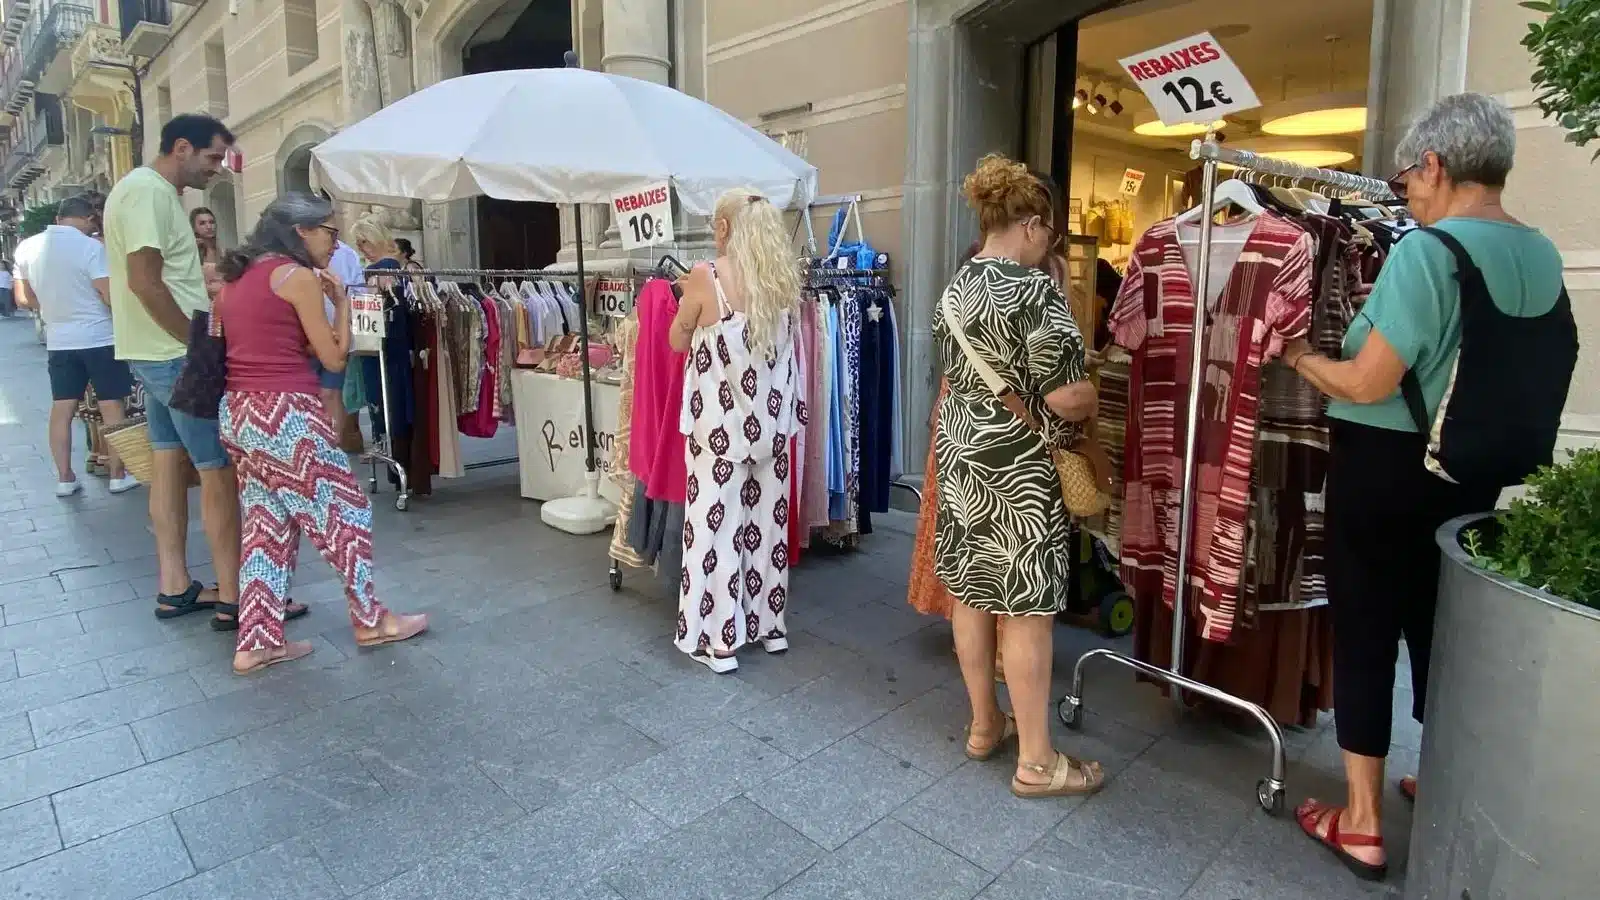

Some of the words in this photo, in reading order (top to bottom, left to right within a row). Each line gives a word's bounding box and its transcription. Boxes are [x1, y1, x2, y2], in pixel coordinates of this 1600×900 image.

[1127, 41, 1220, 81] REBAIXES
[1162, 76, 1233, 113] 12€
[614, 186, 667, 213] REBAIXES
[628, 212, 663, 242] 10€
[600, 294, 626, 312] 10€
[357, 314, 378, 333] 10€
